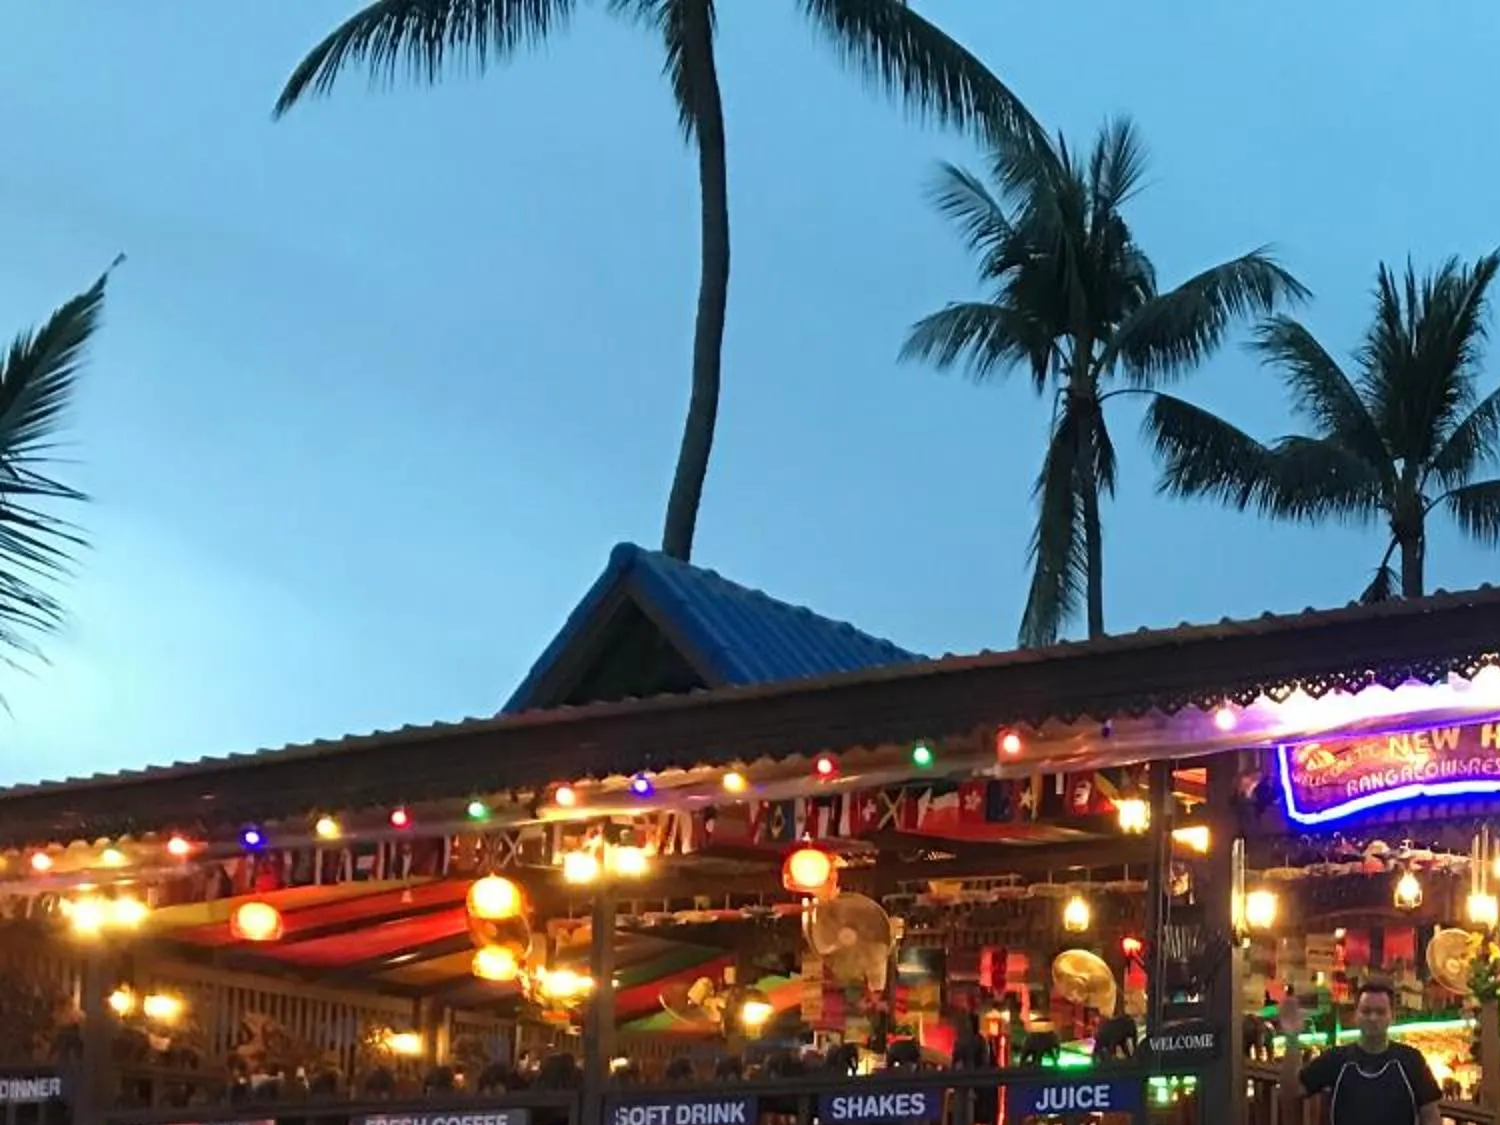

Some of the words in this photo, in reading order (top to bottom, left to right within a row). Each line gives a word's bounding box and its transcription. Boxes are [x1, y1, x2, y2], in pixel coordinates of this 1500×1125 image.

[1388, 726, 1461, 758] NEW
[1148, 1033, 1215, 1051] WELCOME
[0, 1077, 61, 1099] DINNER
[1034, 1084, 1111, 1111] JUICE
[674, 1101, 746, 1125] DRINK
[831, 1092, 926, 1119] SHAKES
